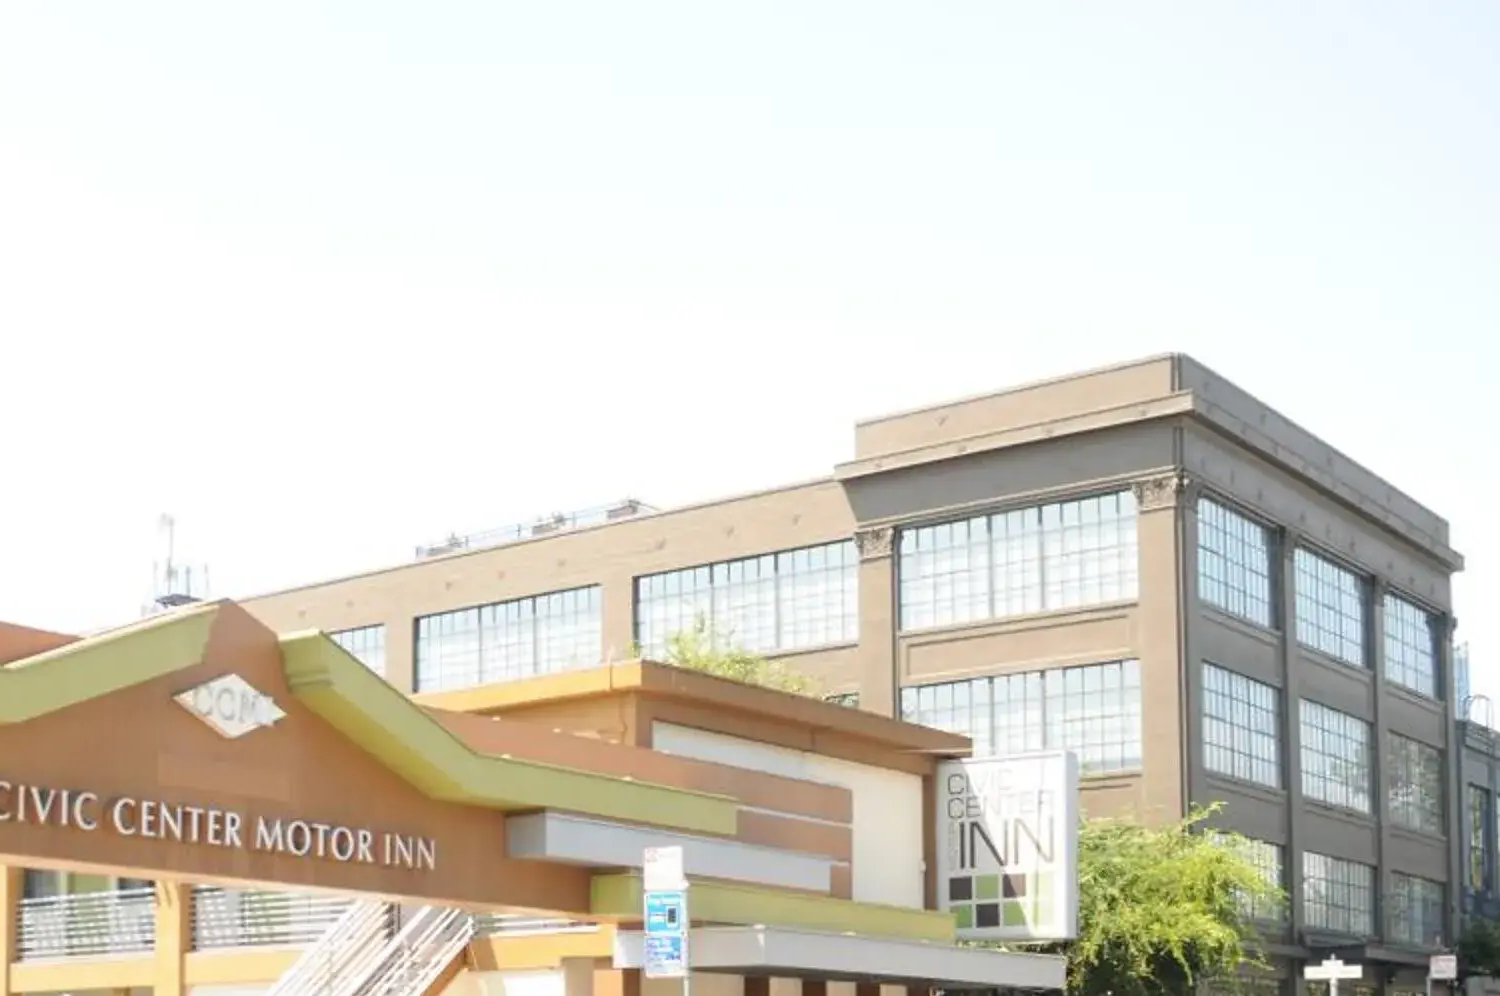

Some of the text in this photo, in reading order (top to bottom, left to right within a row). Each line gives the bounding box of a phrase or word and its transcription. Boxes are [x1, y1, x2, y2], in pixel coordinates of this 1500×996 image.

[947, 768, 1014, 795] CIVIC
[947, 789, 1056, 819] CENTER
[112, 797, 242, 848] CENTER
[255, 815, 375, 863] MOTOR
[384, 832, 436, 871] INN
[959, 816, 1055, 869] INN
